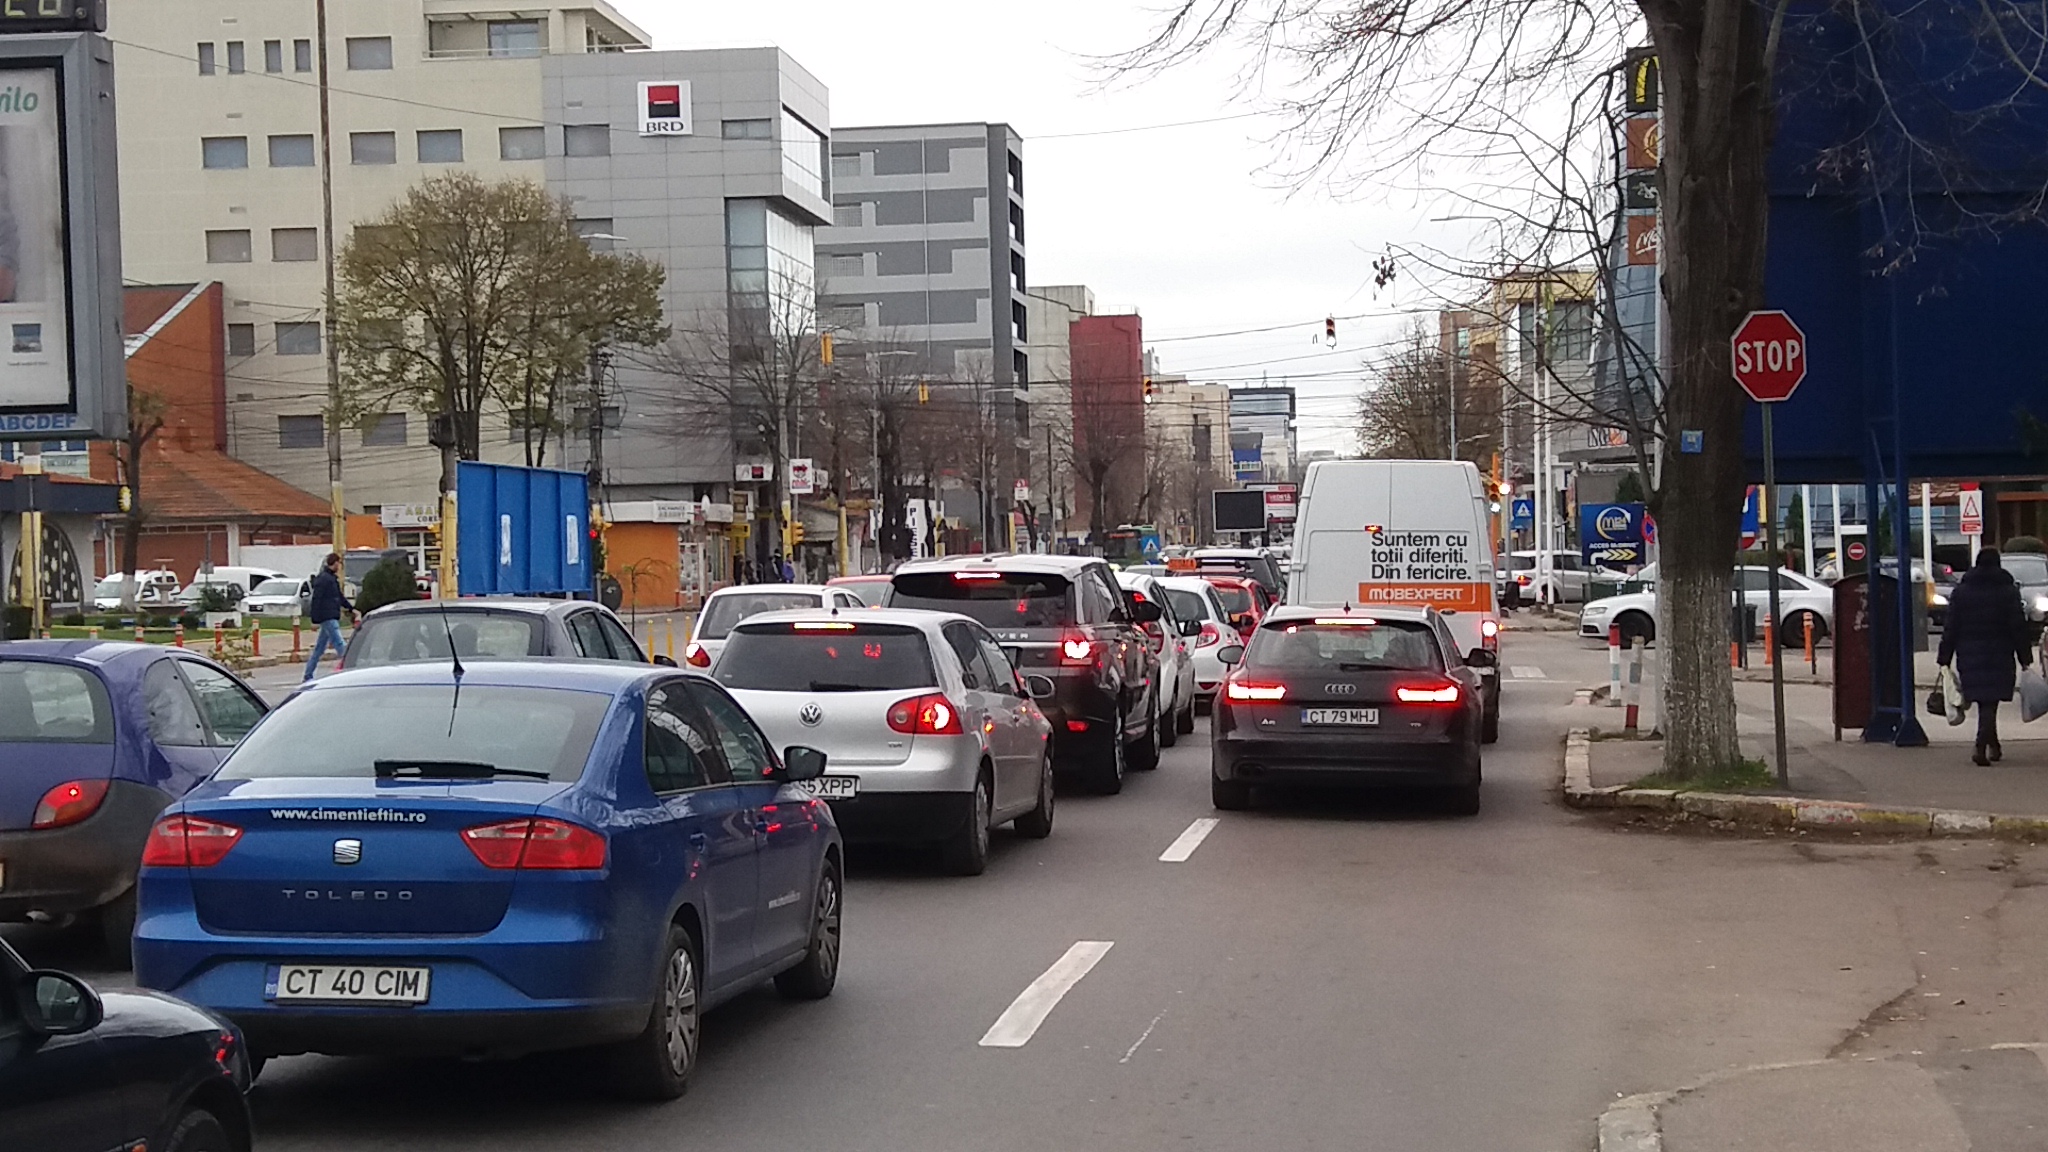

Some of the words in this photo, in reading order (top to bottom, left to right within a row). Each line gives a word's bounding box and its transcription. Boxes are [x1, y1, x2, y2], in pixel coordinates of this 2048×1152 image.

[646, 121, 684, 132] BRD
[1737, 339, 1801, 374] STOP
[1371, 531, 1440, 547] Suntem
[1445, 535, 1468, 547] cu
[1371, 564, 1401, 580] Din
[1406, 564, 1472, 580] fericire.
[1368, 588, 1463, 600] MOBEXPERT
[1309, 711, 1327, 724] CT
[1332, 711, 1347, 724] 79
[1350, 710, 1376, 724] MHJ
[818, 778, 853, 794] XPP
[270, 807, 427, 823] www.cimentieftin.ro
[282, 889, 413, 900] TOLEDO
[286, 969, 323, 995] CT
[331, 969, 365, 995] 40
[374, 970, 420, 997] CIM
